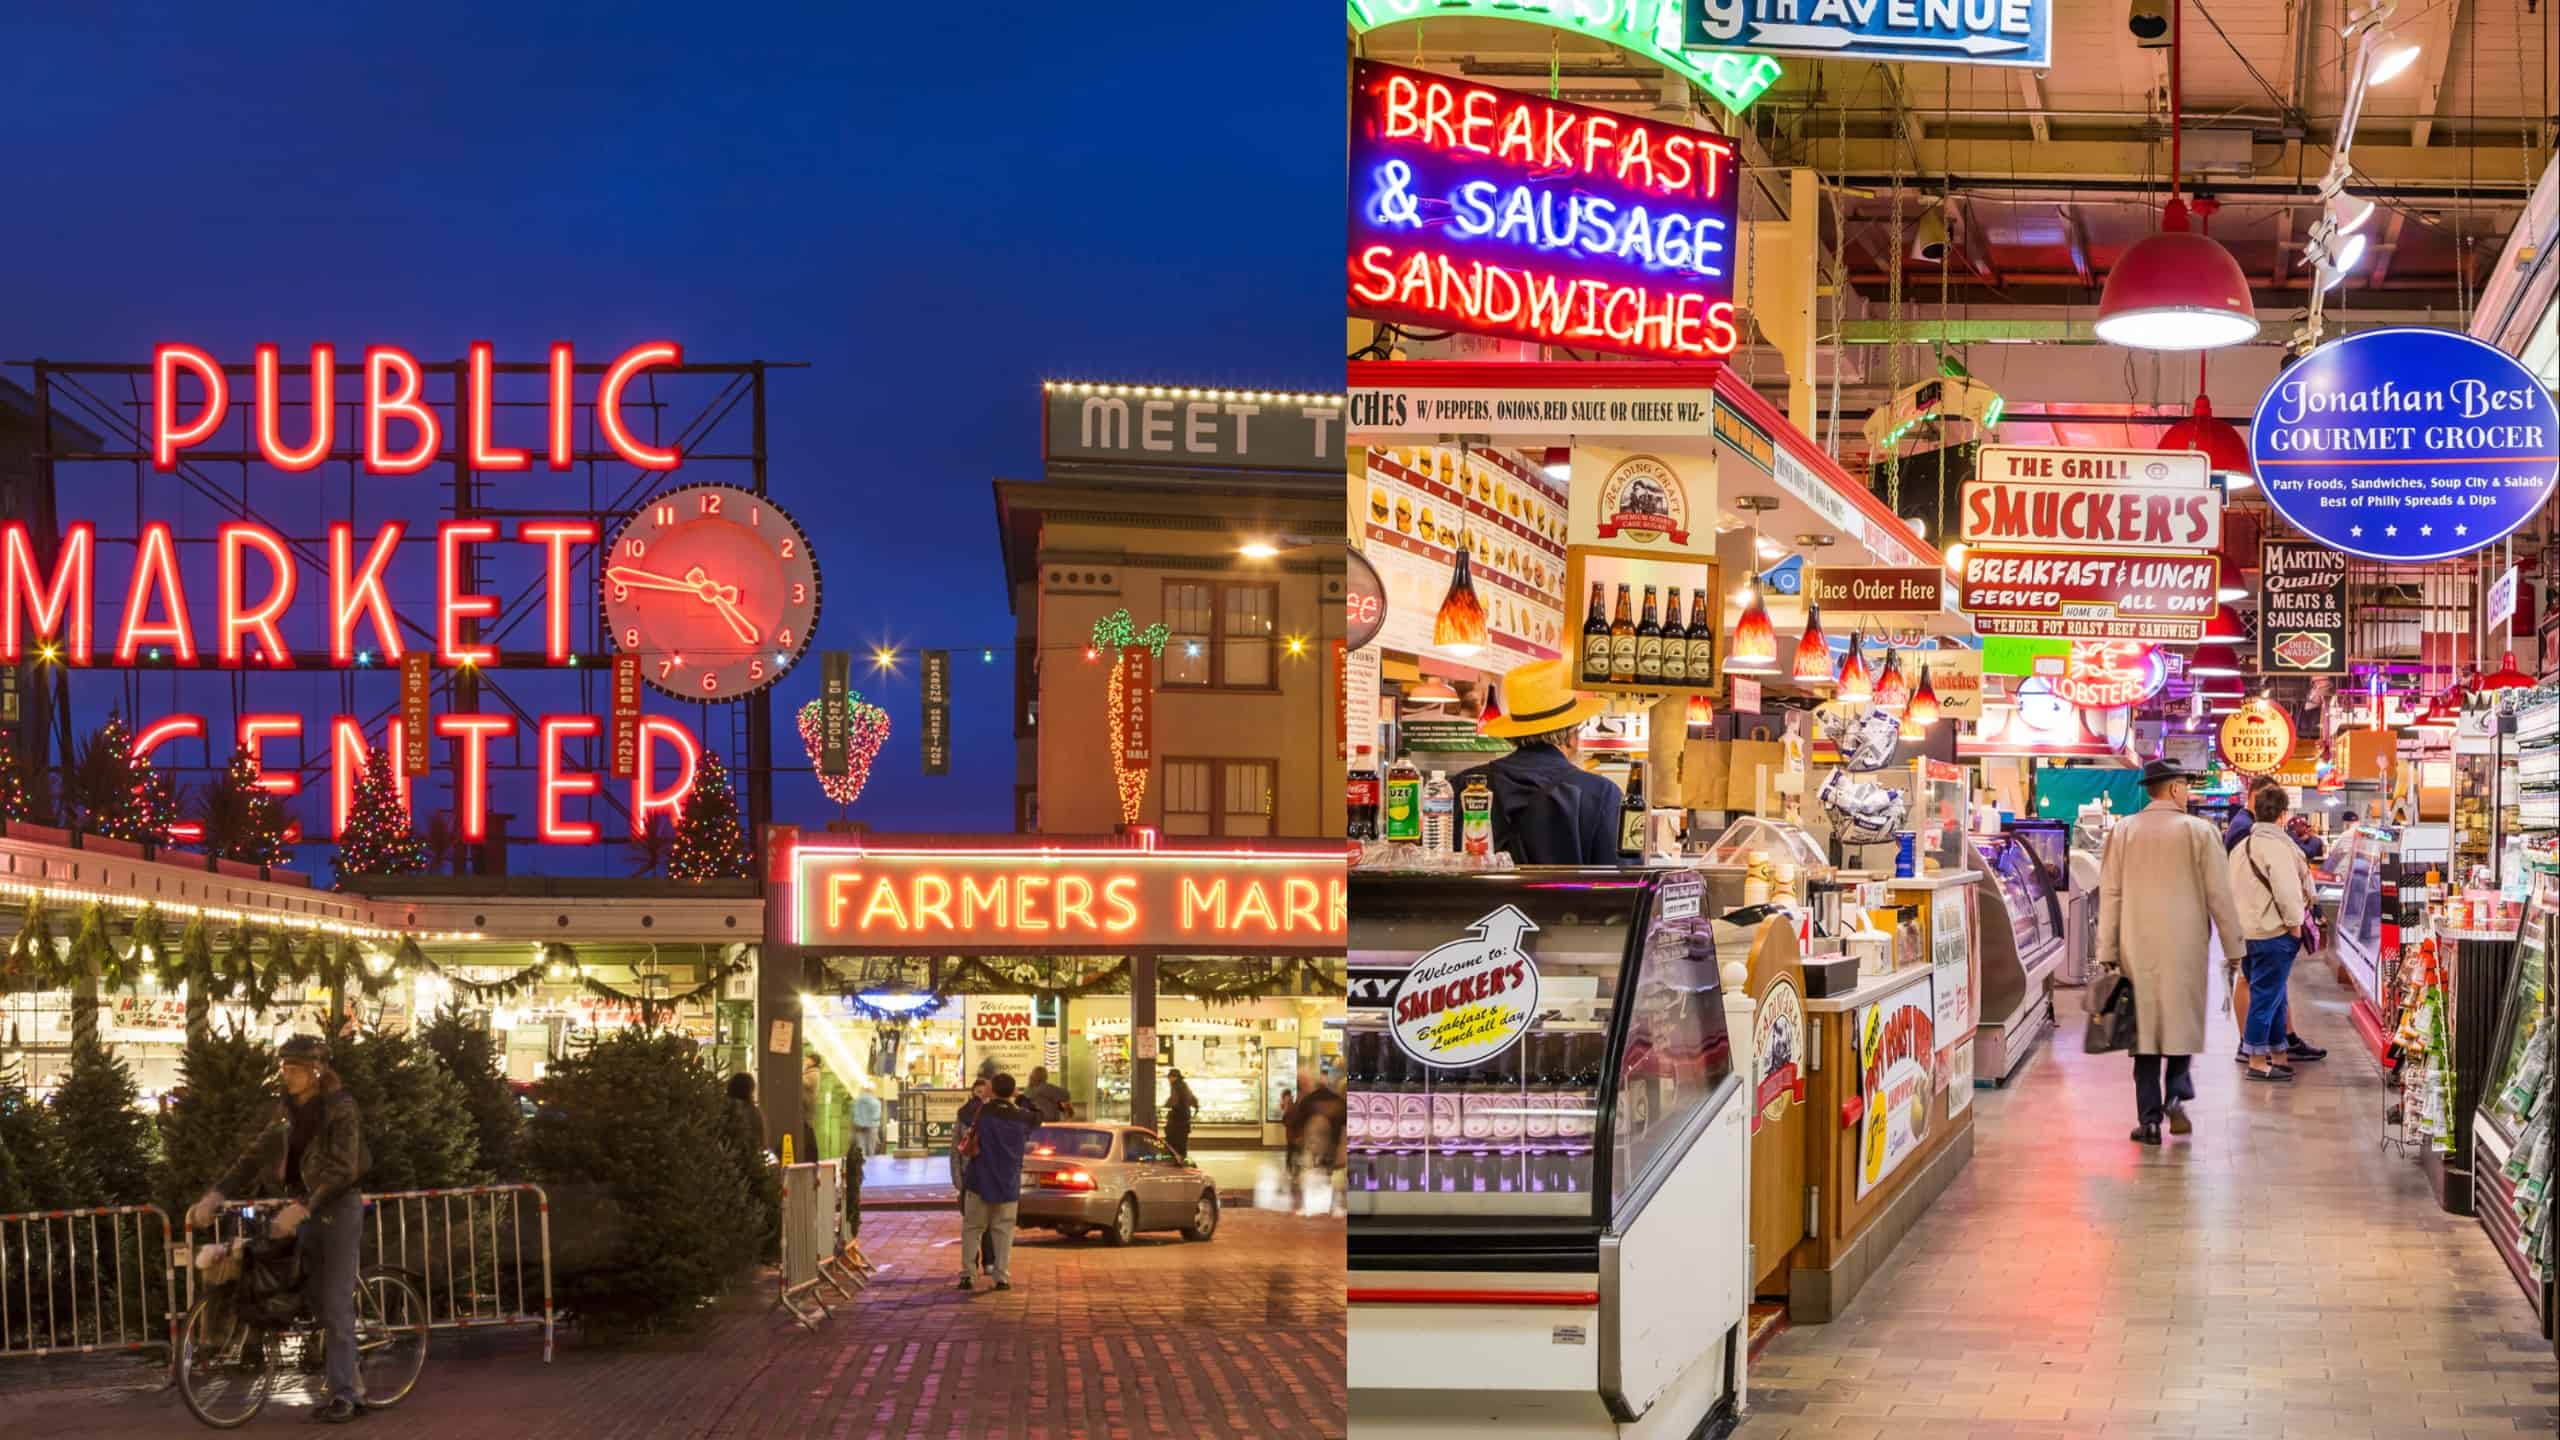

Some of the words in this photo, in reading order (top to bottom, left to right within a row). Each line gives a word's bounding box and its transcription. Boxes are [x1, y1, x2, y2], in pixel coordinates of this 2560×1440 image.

[1811, 0, 2031, 34] AVENUE
[1385, 76, 1732, 198] BREAKFAST
[1381, 160, 1424, 228] &
[1457, 180, 1726, 276] SAUSAGE
[1354, 246, 1738, 355] SANDWICHES
[153, 341, 683, 473] PUBLIC
[1350, 391, 1407, 427] CHES
[1416, 400, 1434, 422] W/
[1436, 400, 1493, 422] PEPPERS,
[1571, 402, 1607, 422] SAUCE
[1610, 402, 1627, 422] OR
[1631, 402, 1674, 422] CHEESE
[2277, 379, 2445, 424] Jonathan
[2450, 378, 2536, 419] Best
[1081, 396, 1261, 454] MEET
[2270, 427, 2416, 451] GOURMET
[2425, 425, 2545, 450] GROCER
[2007, 457, 2053, 478] THE
[2062, 459, 2131, 481] GRILL
[2145, 462, 2169, 480] @
[2273, 479, 2303, 491] Party
[2307, 478, 2347, 490] Foods,
[2351, 477, 2427, 490] Sandwiches,
[2431, 477, 2461, 489] Soup
[2465, 476, 2488, 489] City
[2492, 477, 2500, 488] &
[2504, 475, 2544, 488] Salads
[701, 495, 720, 514] 12
[2320, 496, 2347, 507] Best
[2351, 496, 2363, 506] of
[2367, 495, 2400, 508] Philly
[2404, 495, 2453, 508] Spreads
[2457, 496, 2465, 506] &
[2469, 495, 2497, 507] Dips
[657, 507, 673, 525] 11
[1969, 485, 2209, 543] SMUCKER'S
[625, 540, 645, 558] 10
[781, 539, 793, 558] 2
[2265, 545, 2345, 574] MARTIN'S
[1967, 559, 2117, 587] BREAKFAST
[2116, 560, 2127, 590] &
[2131, 562, 2212, 590] LUNCH
[2265, 572, 2344, 592] Quality
[0, 520, 598, 668] MARKET
[614, 583, 628, 602] 9
[793, 584, 805, 603] 3
[1810, 579, 1847, 599] Place
[1853, 579, 1895, 599] Order
[1901, 579, 1935, 599] Here
[1969, 590, 2061, 606] SERVED
[2119, 594, 2155, 610] ALL
[2167, 596, 2212, 611] DAY
[2272, 594, 2320, 609] MEATS
[2324, 594, 2335, 609] &
[2066, 606, 2091, 618] HOME
[2097, 607, 2111, 618] OF
[2267, 612, 2342, 628] SAUSAGES
[625, 629, 639, 647] 8
[780, 629, 793, 647] 4
[1978, 620, 1992, 629] THE
[1993, 619, 2038, 633] TENDER
[2043, 621, 2064, 634] POT
[2068, 622, 2104, 635] ROAST
[2107, 622, 2136, 636] BEEF
[2139, 623, 2198, 638] SANDWICH
[2284, 648, 2321, 657] WATSON
[659, 661, 672, 679] 7
[751, 661, 763, 679] 5
[1131, 653, 1143, 679] THE
[702, 673, 717, 690] 6
[2051, 679, 2146, 706] LOBSTERS
[826, 701, 844, 750] NEWBOLD
[1131, 688, 1144, 747] SPANISH
[2231, 736, 2278, 748] PORK
[2234, 752, 2278, 764] BEEF
[130, 712, 705, 843] CENTER
[827, 873, 1139, 931] FARMERS
[1413, 954, 1483, 984] Welcome
[1488, 946, 1508, 961] to:
[1396, 959, 1525, 1026] SMUCKER'S
[976, 1012, 1031, 1031] DOWN
[1416, 1009, 1488, 1042] Breakfast
[1489, 1006, 1498, 1016] &
[1429, 1029, 1474, 1051] Lunch
[1476, 1017, 1496, 1035] all
[1499, 1010, 1526, 1027] day
[971, 1027, 1030, 1041] UNDER
